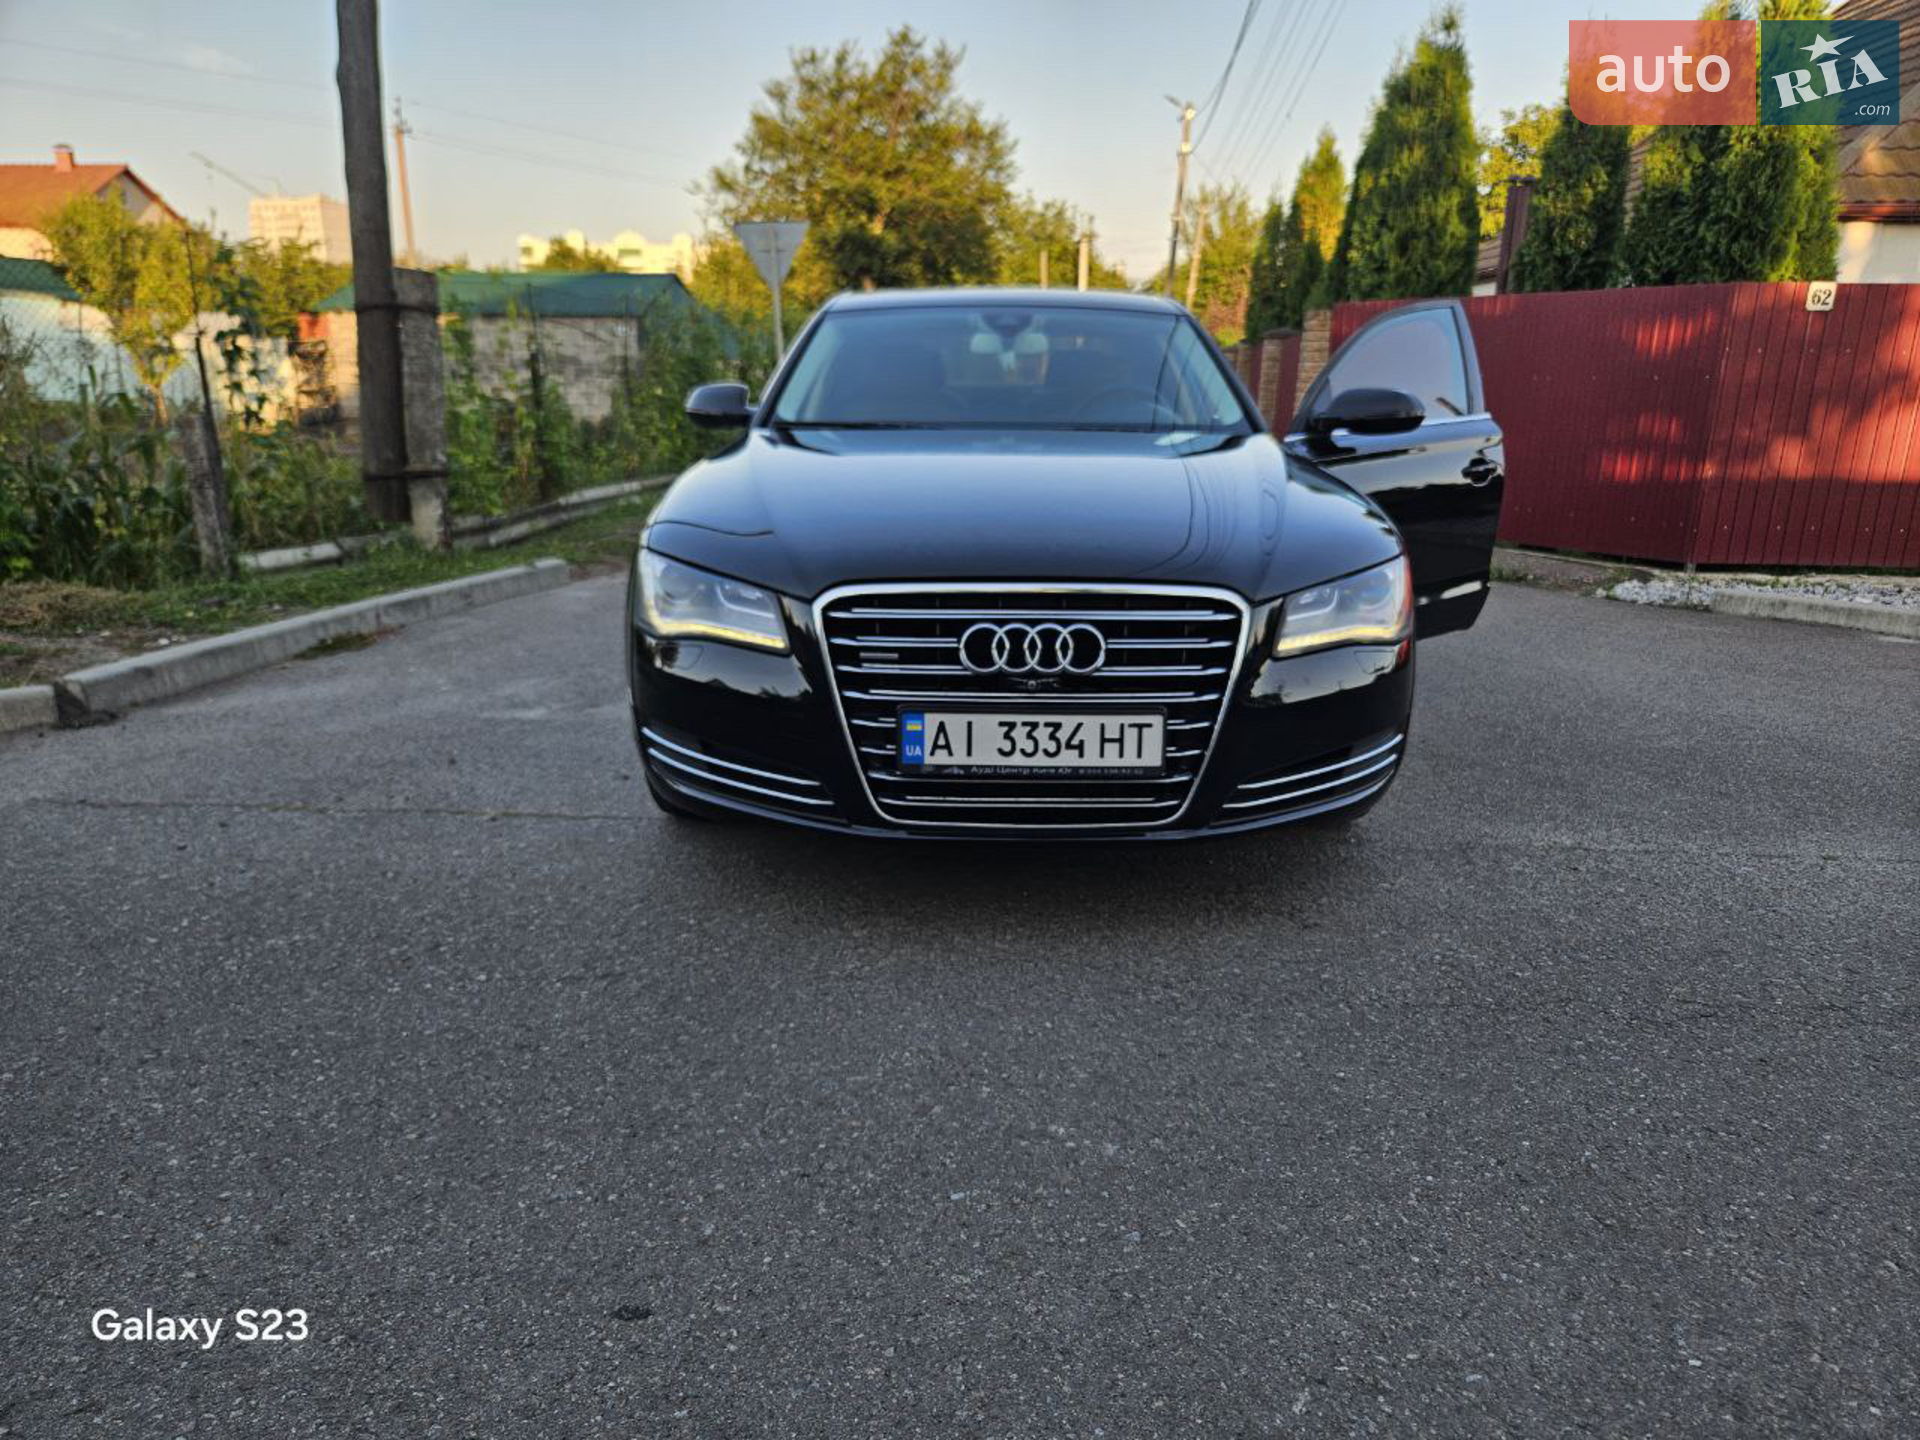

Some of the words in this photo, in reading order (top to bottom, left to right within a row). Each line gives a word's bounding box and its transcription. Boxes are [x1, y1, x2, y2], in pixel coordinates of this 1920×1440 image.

[1811, 288, 1832, 306] 62
[929, 721, 973, 757] AI
[996, 721, 1085, 758] 3334
[1099, 723, 1153, 758] HT
[906, 745, 922, 757] UA
